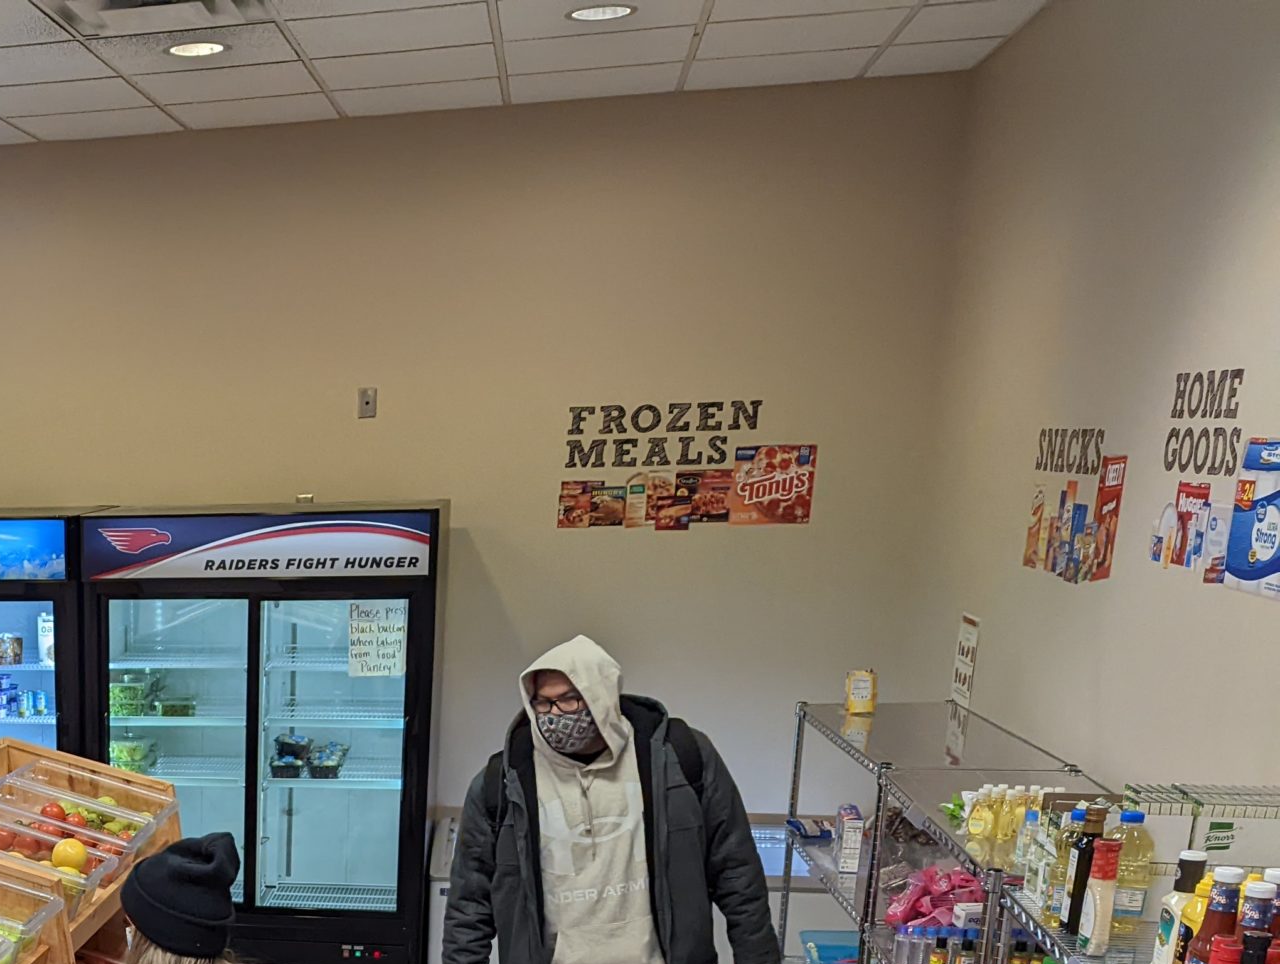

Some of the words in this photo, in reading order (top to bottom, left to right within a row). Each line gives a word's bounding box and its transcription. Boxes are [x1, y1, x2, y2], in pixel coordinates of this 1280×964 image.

[1171, 368, 1245, 419] HOME
[567, 400, 763, 435] FROZEN
[565, 435, 728, 468] MEALS
[1035, 428, 1105, 476] SNACKS
[1163, 427, 1242, 477] GOODS
[737, 470, 808, 504] Tony's
[204, 558, 280, 571] RAIDERS
[285, 557, 340, 570] FIGHT
[344, 556, 420, 569] HUNGER
[350, 603, 380, 619] Please
[386, 606, 406, 621] press
[350, 623, 375, 635] black
[377, 623, 405, 634] button
[350, 648, 370, 660] from
[377, 649, 396, 660] food
[376, 637, 402, 653] taking
[1204, 834, 1235, 844] Knorr
